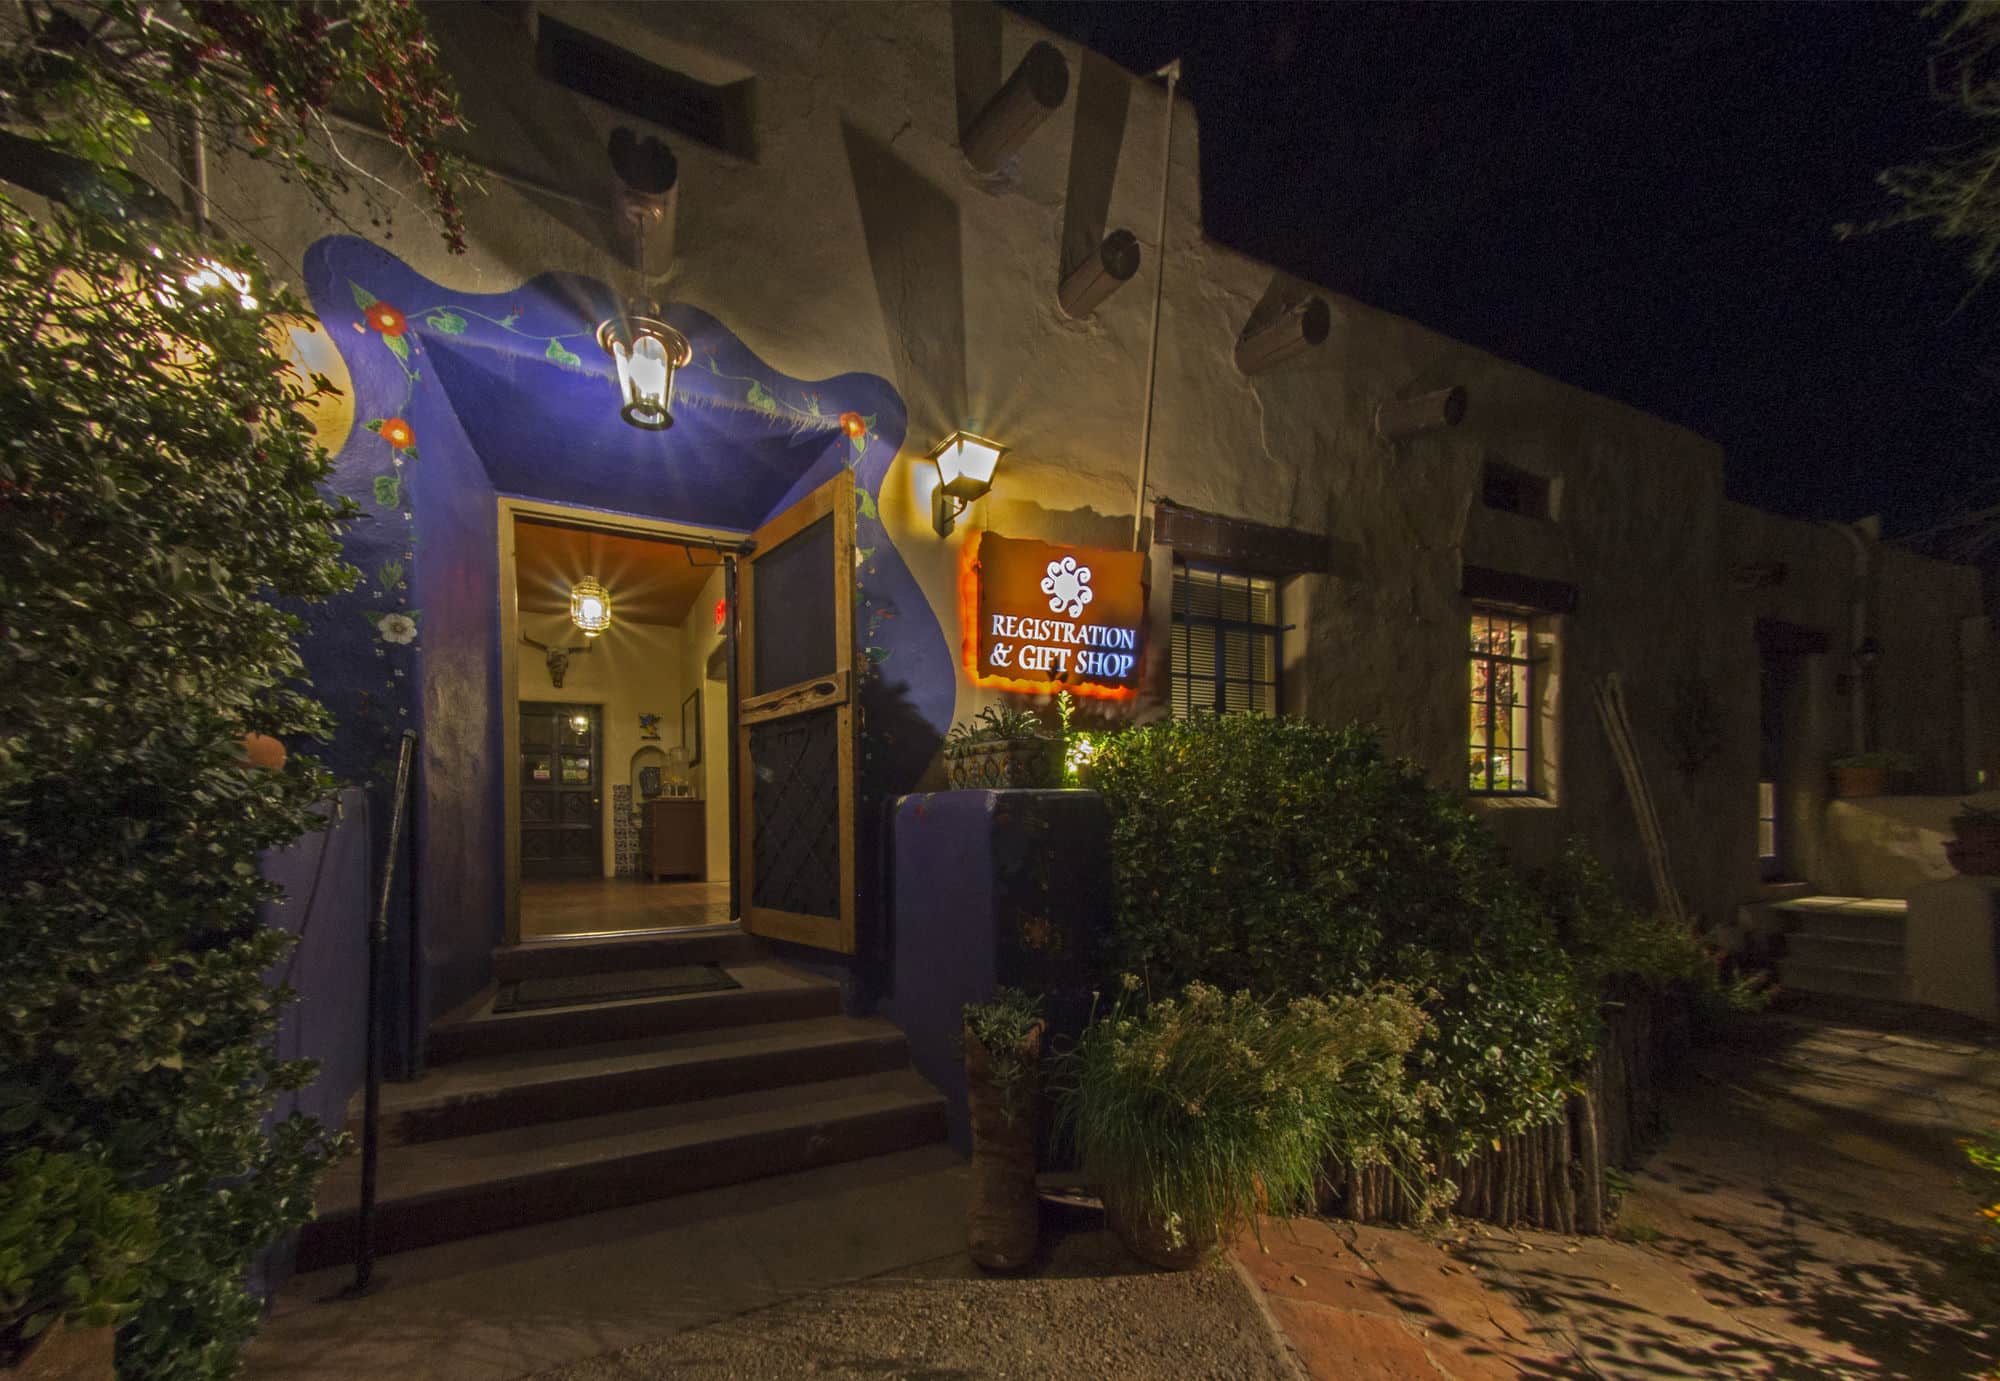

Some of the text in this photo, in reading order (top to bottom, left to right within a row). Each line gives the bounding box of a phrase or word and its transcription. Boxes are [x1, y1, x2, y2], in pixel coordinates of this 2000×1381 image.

[991, 614, 1136, 649] REGISTRATION
[990, 642, 1134, 678] & GIFT SHOP
